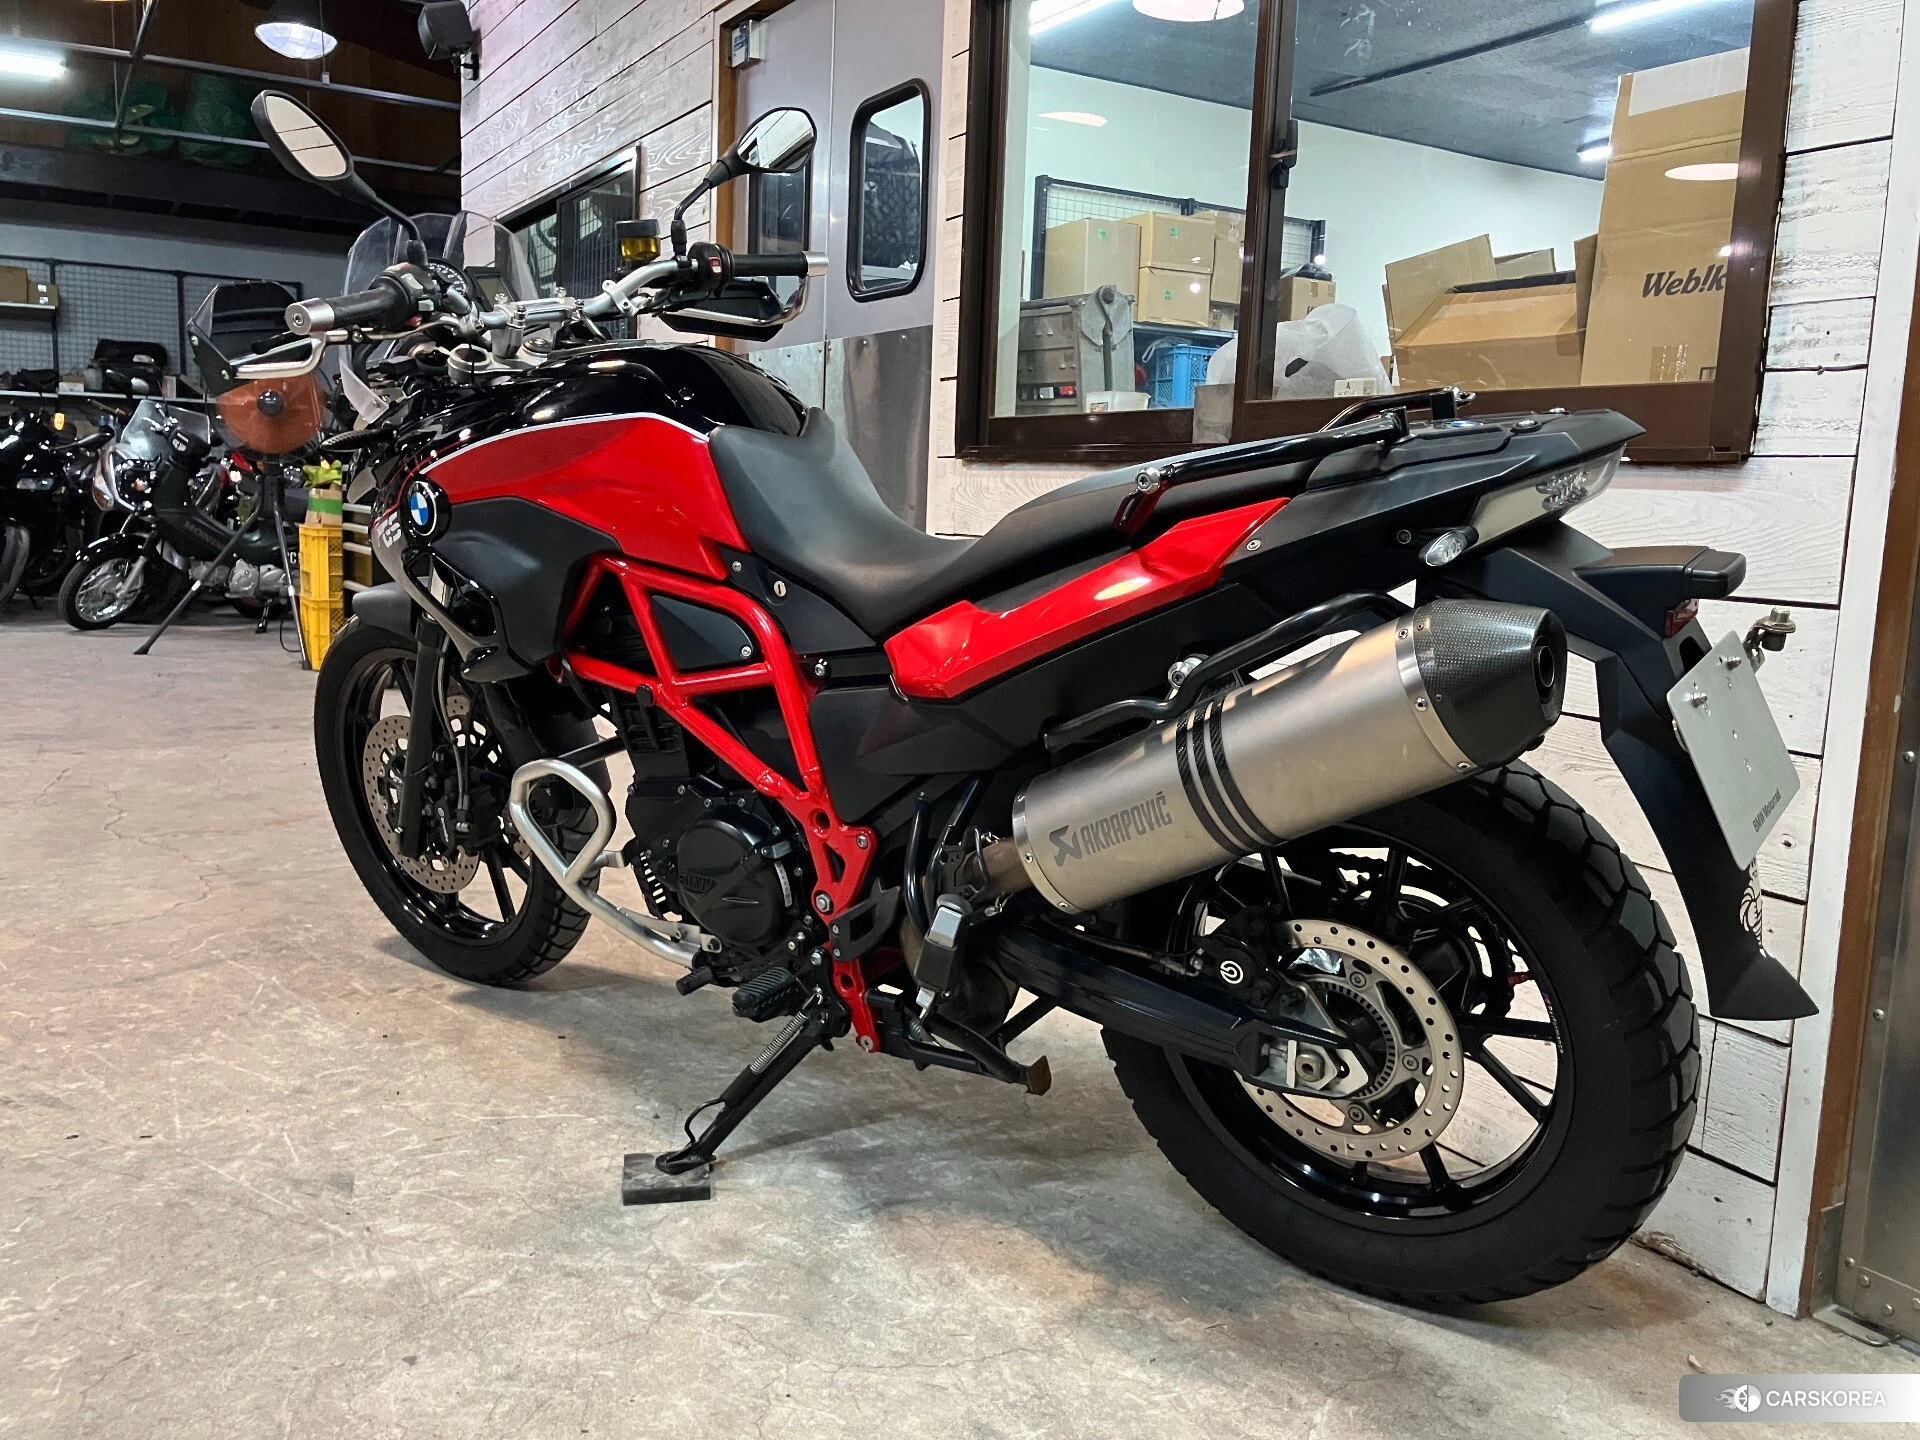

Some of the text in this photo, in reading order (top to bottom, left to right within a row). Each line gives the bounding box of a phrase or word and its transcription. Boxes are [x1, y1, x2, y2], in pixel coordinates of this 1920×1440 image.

[1752, 787, 1782, 833] BMW Motorrad
[1547, 1005, 1564, 1054] Performance
